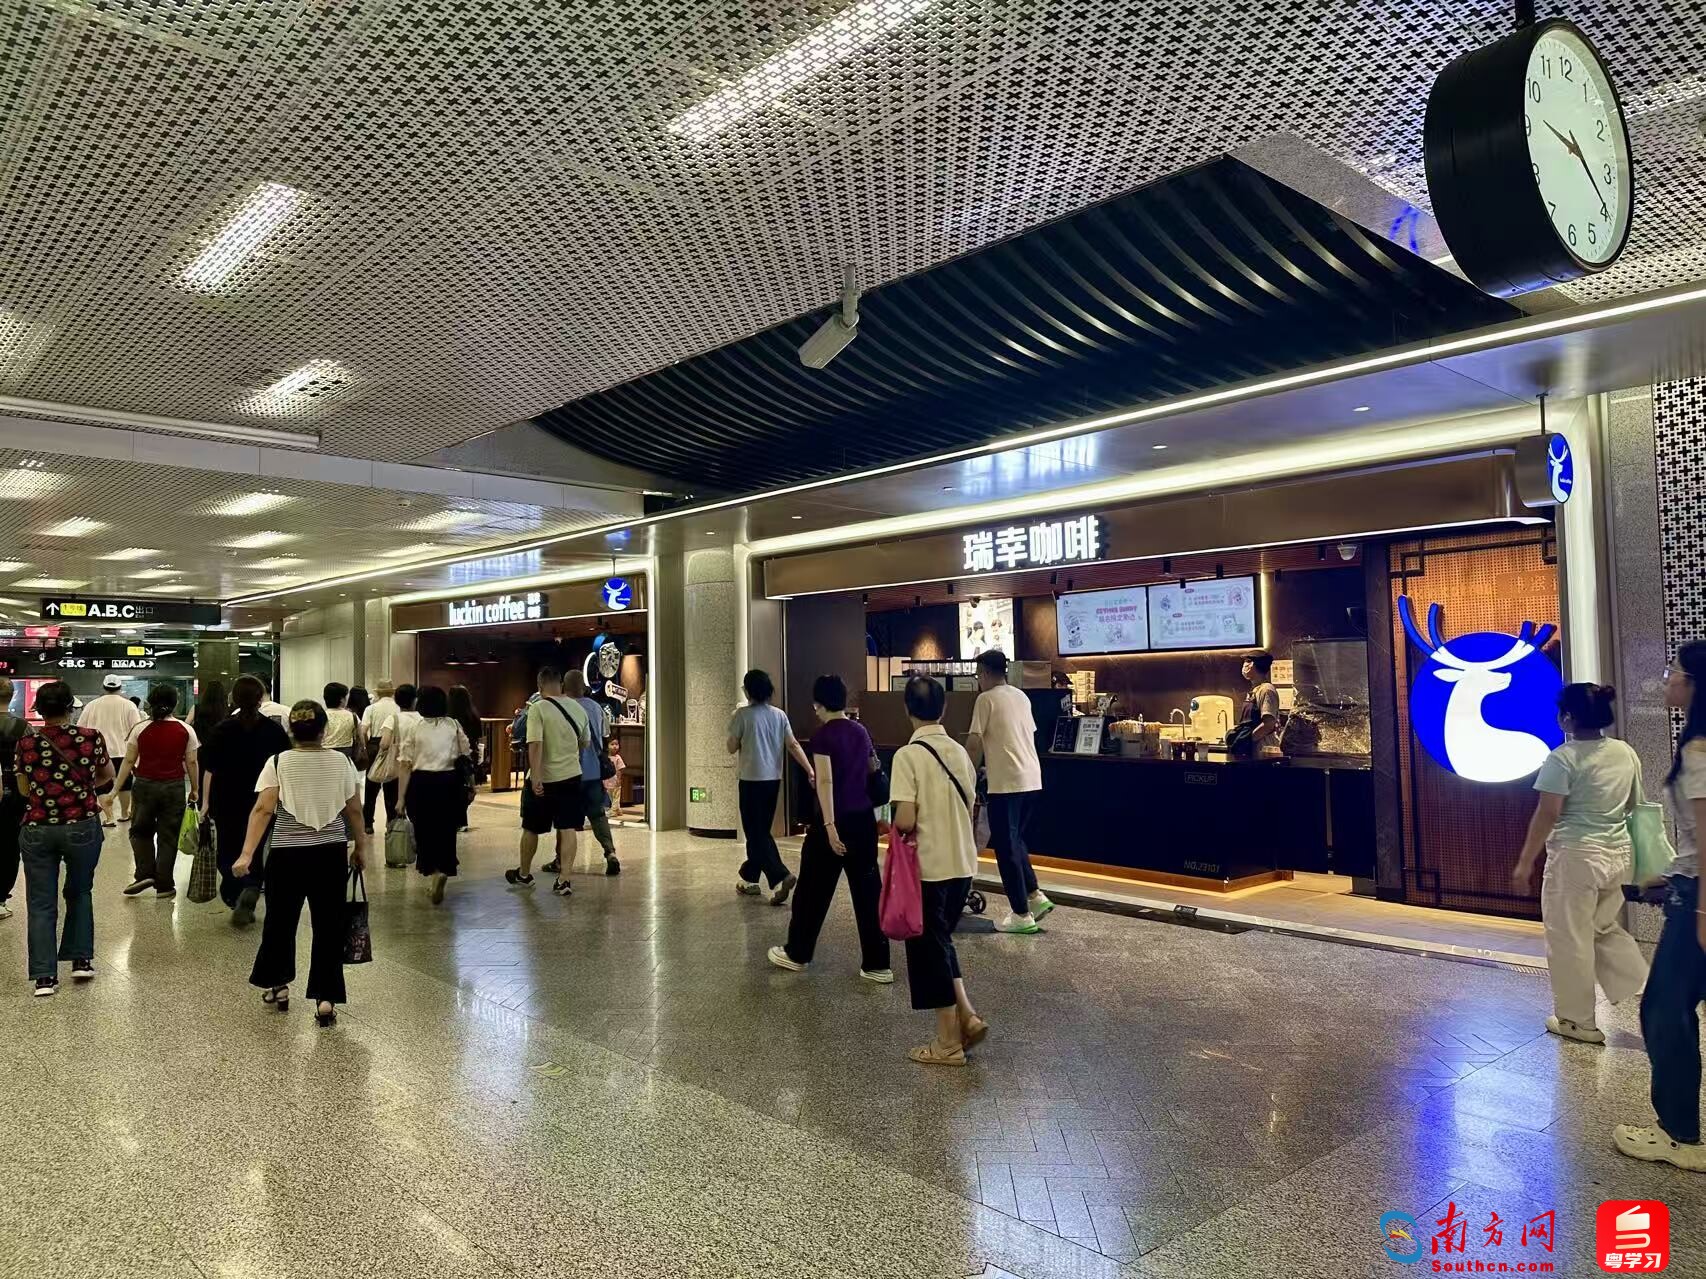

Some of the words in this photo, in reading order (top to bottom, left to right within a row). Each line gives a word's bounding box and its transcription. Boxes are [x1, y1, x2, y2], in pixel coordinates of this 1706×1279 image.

[1541, 55, 1553, 80] 11
[1559, 56, 1574, 83] 12
[1527, 77, 1541, 104] 10
[1582, 82, 1588, 103] 1
[1596, 119, 1607, 142] 2
[1603, 163, 1612, 185] 3
[1600, 203, 1611, 223] 4
[1568, 224, 1577, 246] 6
[1587, 222, 1597, 245] 5
[962, 514, 1100, 572] 瑞幸咖啡
[88, 604, 135, 618] A.B.C
[135, 605, 154, 614] 出口
[449, 599, 484, 626] luckin
[486, 595, 526, 622] coffee
[67, 660, 86, 668] B.C
[128, 659, 147, 668] A.D
